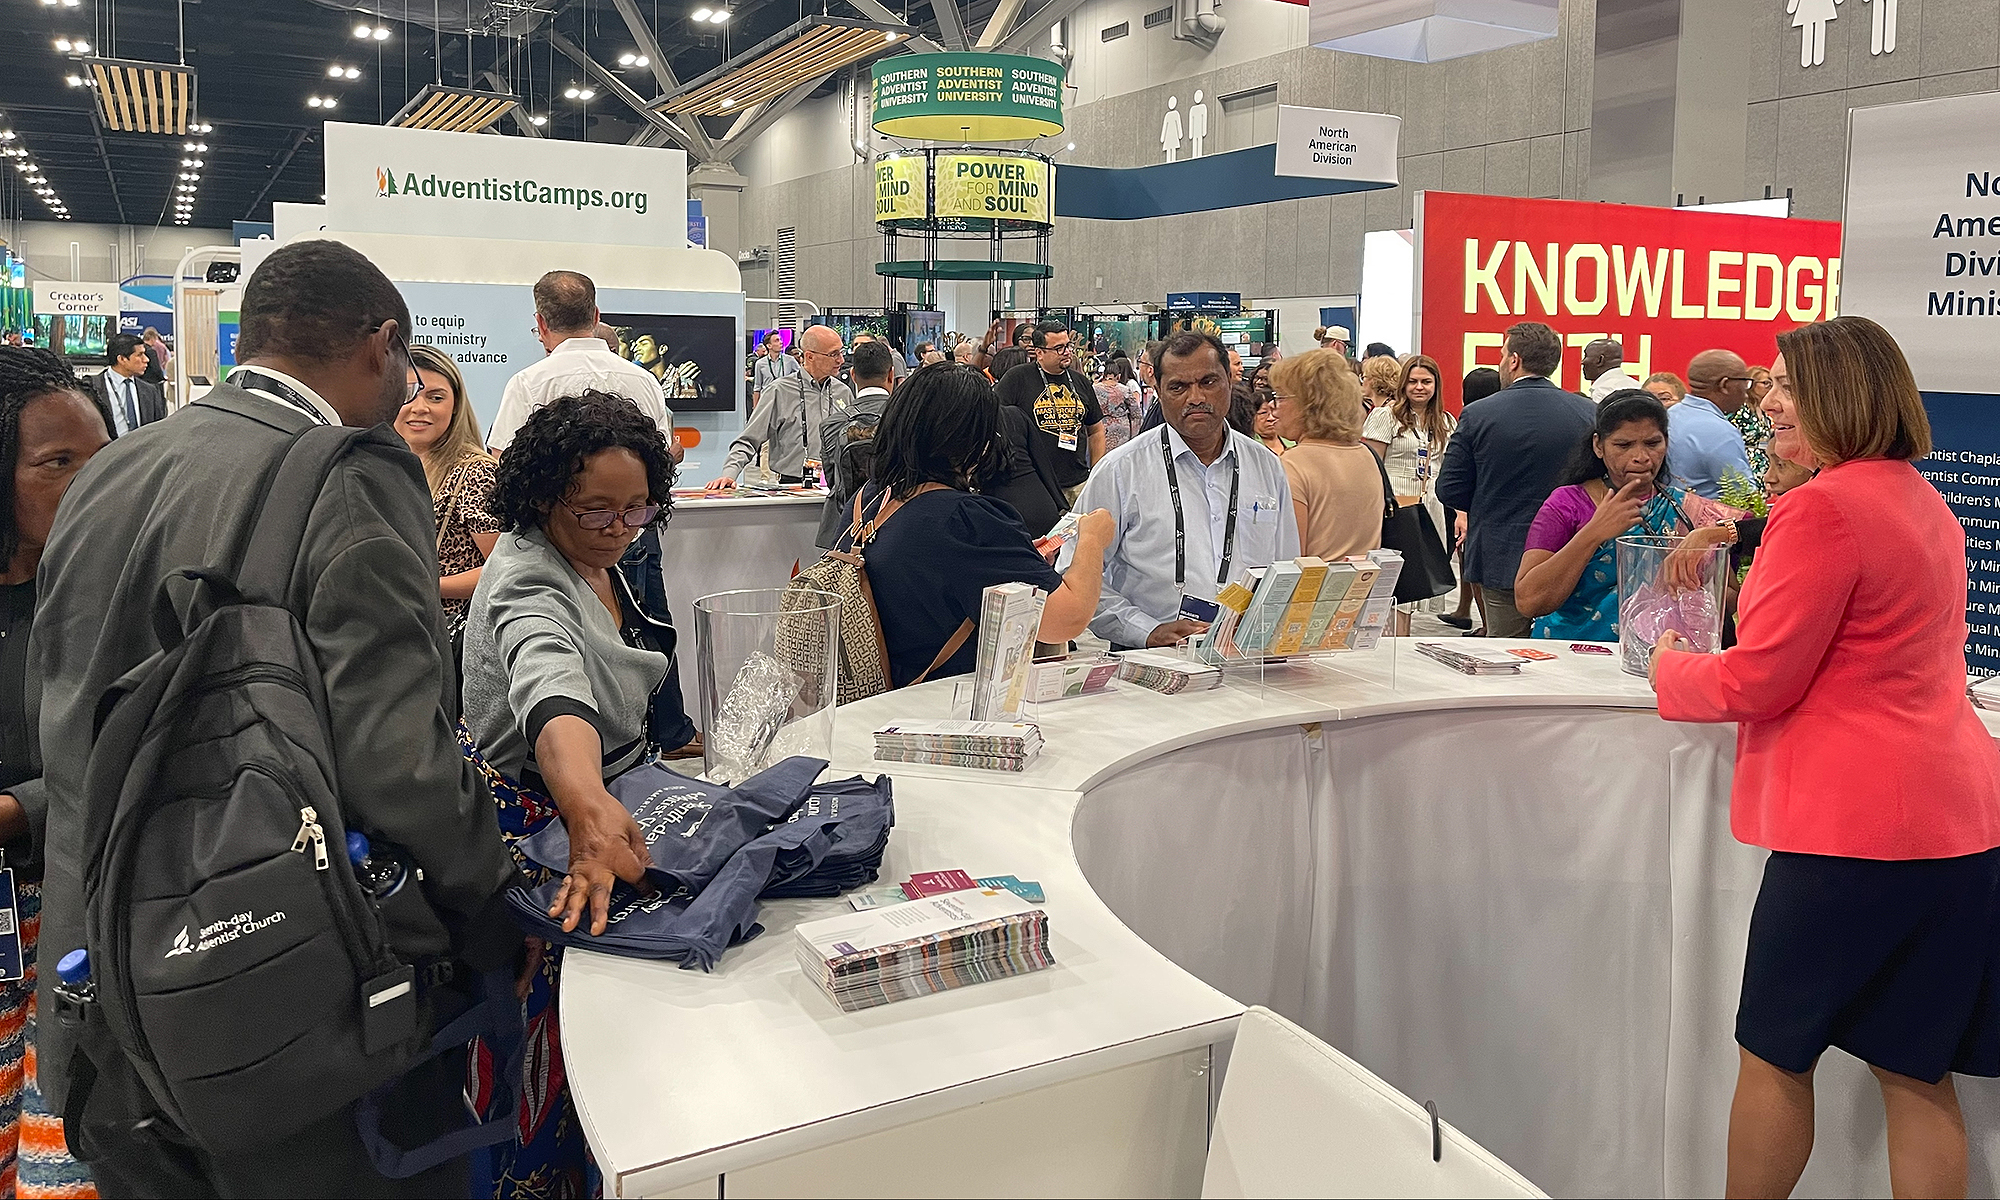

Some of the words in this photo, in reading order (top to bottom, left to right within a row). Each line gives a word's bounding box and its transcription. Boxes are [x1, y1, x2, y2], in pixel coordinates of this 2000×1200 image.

[880, 69, 928, 84] SOUTHERN
[936, 67, 1003, 78] SOUTHERN
[1011, 69, 1057, 86] SOUTHERN
[881, 80, 927, 97] ADVENTIST
[937, 79, 1003, 90] ADVENTIST
[1012, 82, 1057, 98] ADVENTIST
[881, 93, 929, 108] UNIVERSITY
[937, 92, 1003, 102] UNIVERSITY
[1012, 94, 1057, 109] UNIVERSITY
[1319, 126, 1349, 139] North
[1308, 139, 1357, 153] American
[1312, 152, 1352, 166] Division
[957, 162, 1025, 180] POWER
[402, 172, 648, 214] AdventistCamps.org
[878, 180, 911, 198] MIND
[966, 182, 995, 195] FOR
[998, 182, 1039, 198] MIND
[952, 198, 982, 211] AND
[984, 197, 1028, 213] SOUL
[49, 291, 104, 303] Creator's
[57, 302, 99, 312] Corner
[415, 315, 427, 327] to
[431, 315, 465, 329] equip
[437, 332, 487, 348] ministry
[457, 351, 508, 363] advance
[242, 910, 286, 935] Church
